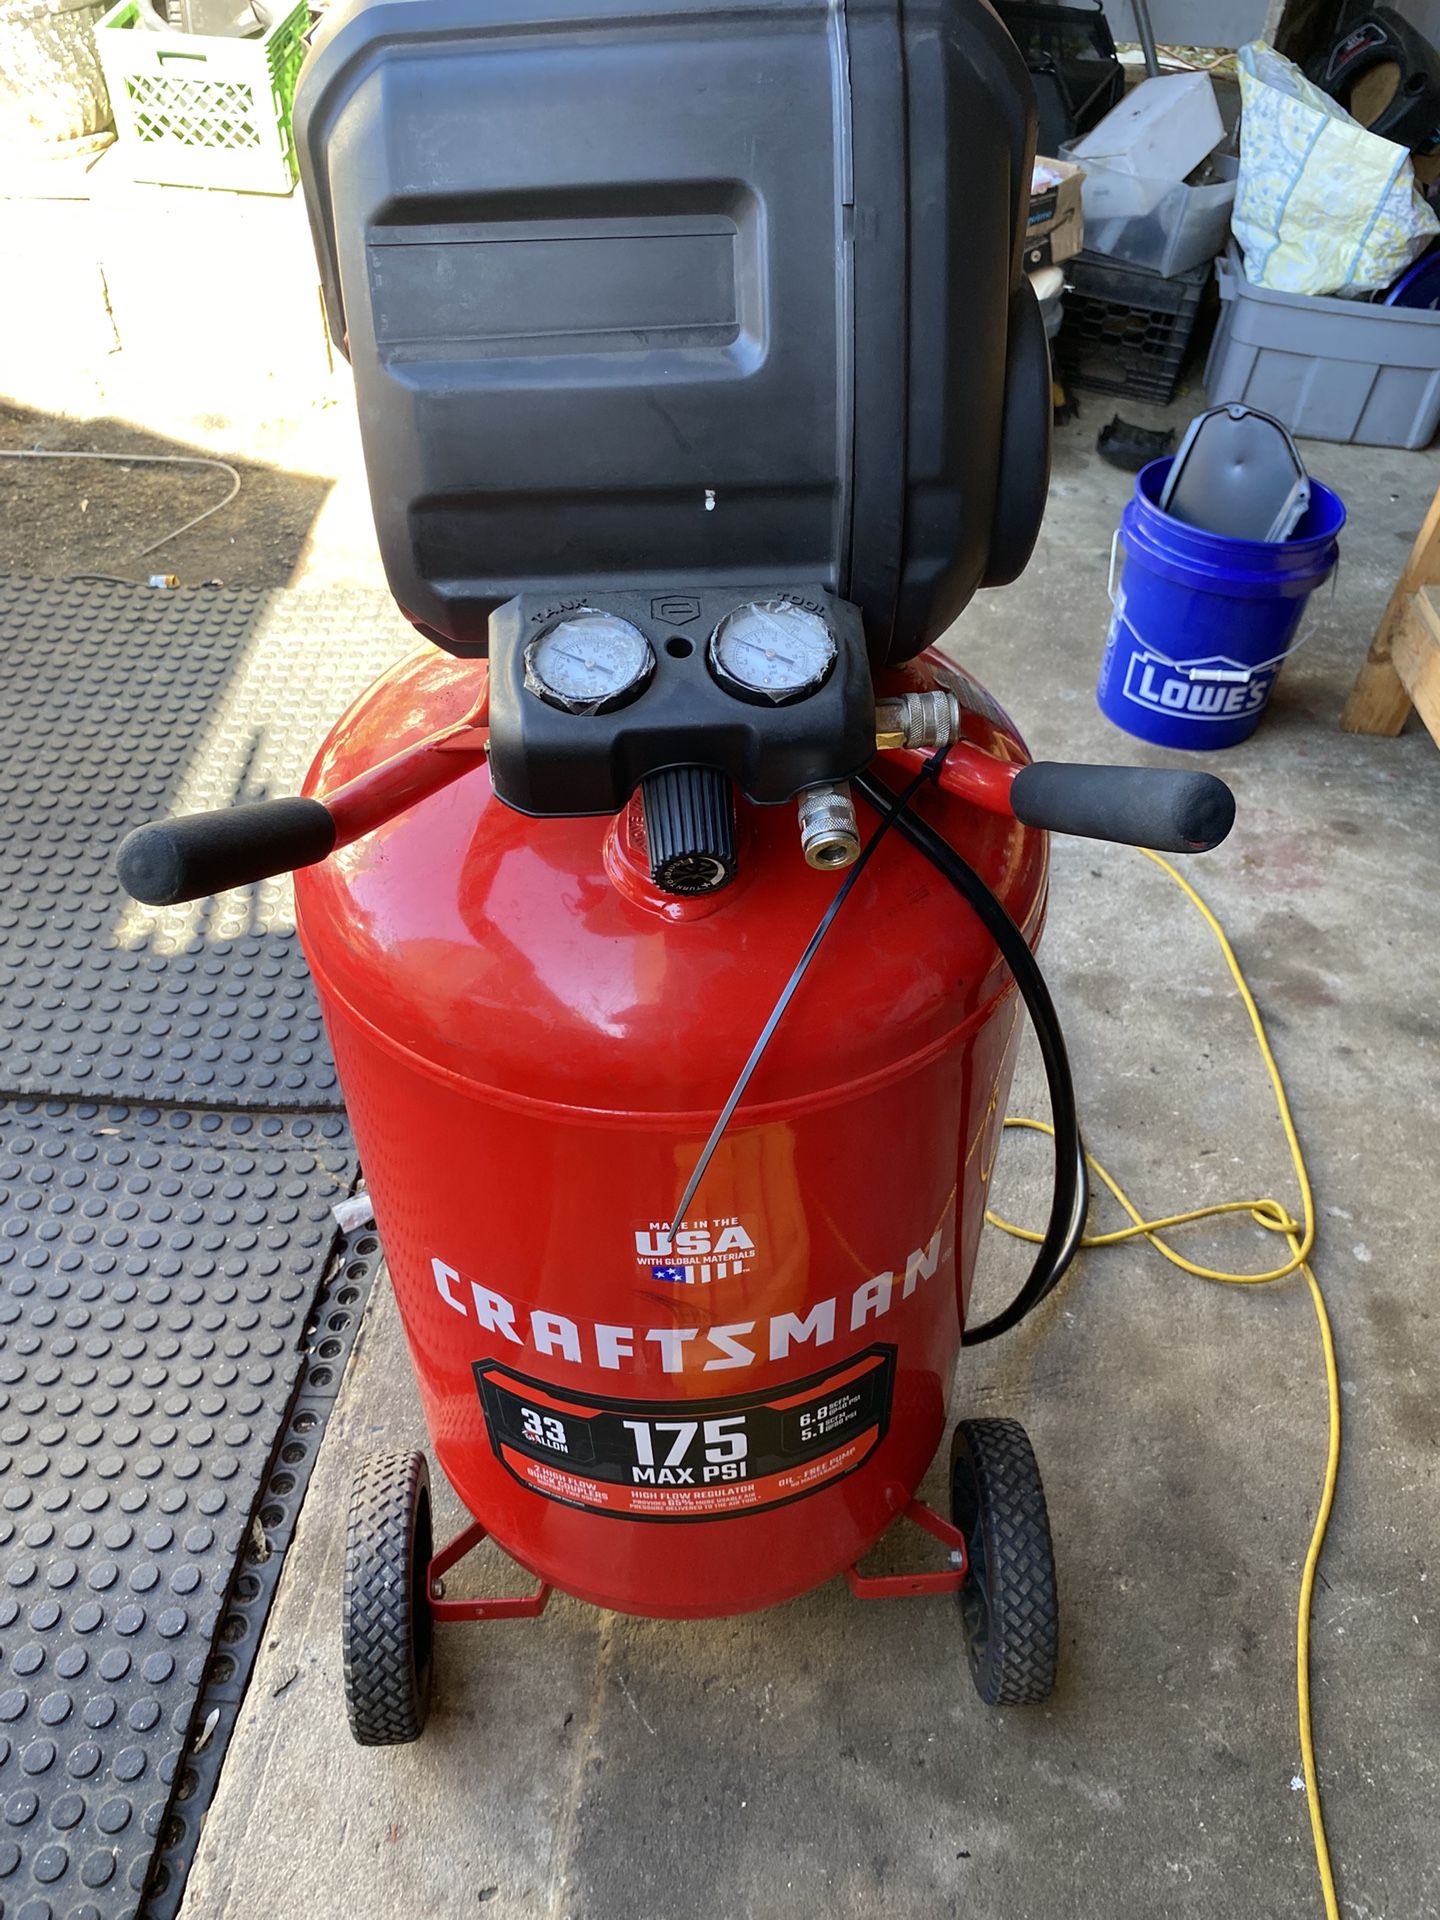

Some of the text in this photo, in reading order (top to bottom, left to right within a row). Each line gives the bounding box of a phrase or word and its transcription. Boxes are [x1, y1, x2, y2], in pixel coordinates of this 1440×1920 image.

[531, 599, 589, 623] TANK
[777, 593, 825, 619] TOOL
[1139, 664, 1267, 713] LOWE'S
[694, 1221, 708, 1229] IN
[713, 1217, 739, 1228] THE
[635, 1226, 755, 1256] USA
[637, 1250, 756, 1265] WITH GLOBAL MATERIALS
[430, 1228, 943, 1373] CRAFTSMAN
[848, 1394, 861, 1406] PSI
[521, 1408, 566, 1443] 33
[800, 1406, 828, 1427] 6.8
[623, 1415, 748, 1467] 175
[801, 1422, 825, 1441] 5.1
[542, 1467, 567, 1481] HIGH
[567, 1476, 597, 1491] FLOW
[632, 1461, 747, 1484] MAX PSI
[778, 1476, 794, 1487] OIL
[803, 1463, 828, 1478] FREE
[829, 1447, 856, 1465] PUMP
[527, 1467, 555, 1482] QUICK
[557, 1480, 609, 1501] COUPLERS
[631, 1484, 755, 1500] HIGH FLOW REGULATOR
